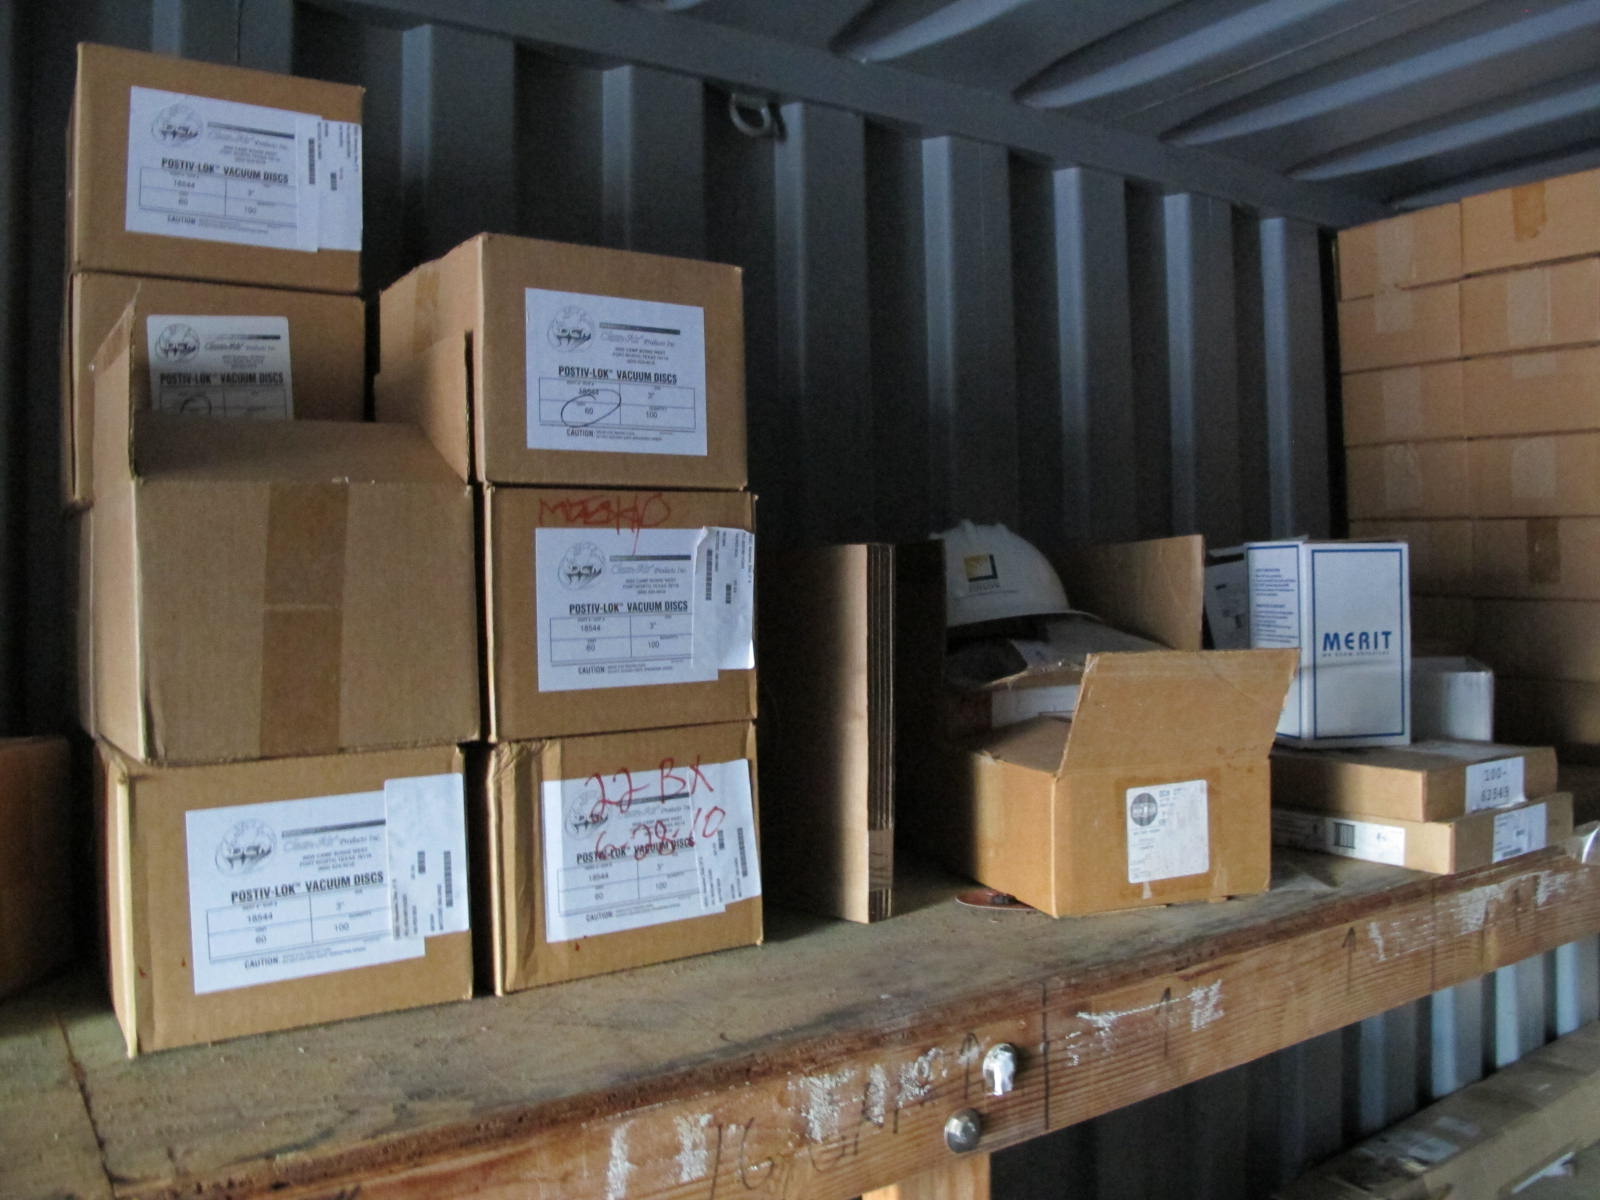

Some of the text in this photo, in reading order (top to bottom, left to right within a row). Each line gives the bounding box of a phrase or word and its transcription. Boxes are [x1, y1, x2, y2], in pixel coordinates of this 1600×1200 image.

[223, 166, 261, 180] VACUUM
[263, 171, 289, 184] DISCS
[167, 215, 196, 225] CAUTION
[616, 370, 652, 382] VACUUM
[654, 373, 678, 385] DISCS
[566, 429, 594, 438] CAUTION
[627, 602, 663, 613] VACUUM
[664, 600, 688, 612] DISCS
[1323, 631, 1393, 652] MERIT
[578, 666, 605, 675] CAUTION
[305, 874, 351, 893] VACUUM
[353, 871, 384, 886] DISCS
[586, 911, 613, 922] CAUTION
[334, 922, 350, 932] 100
[244, 957, 279, 970] CAUTION
